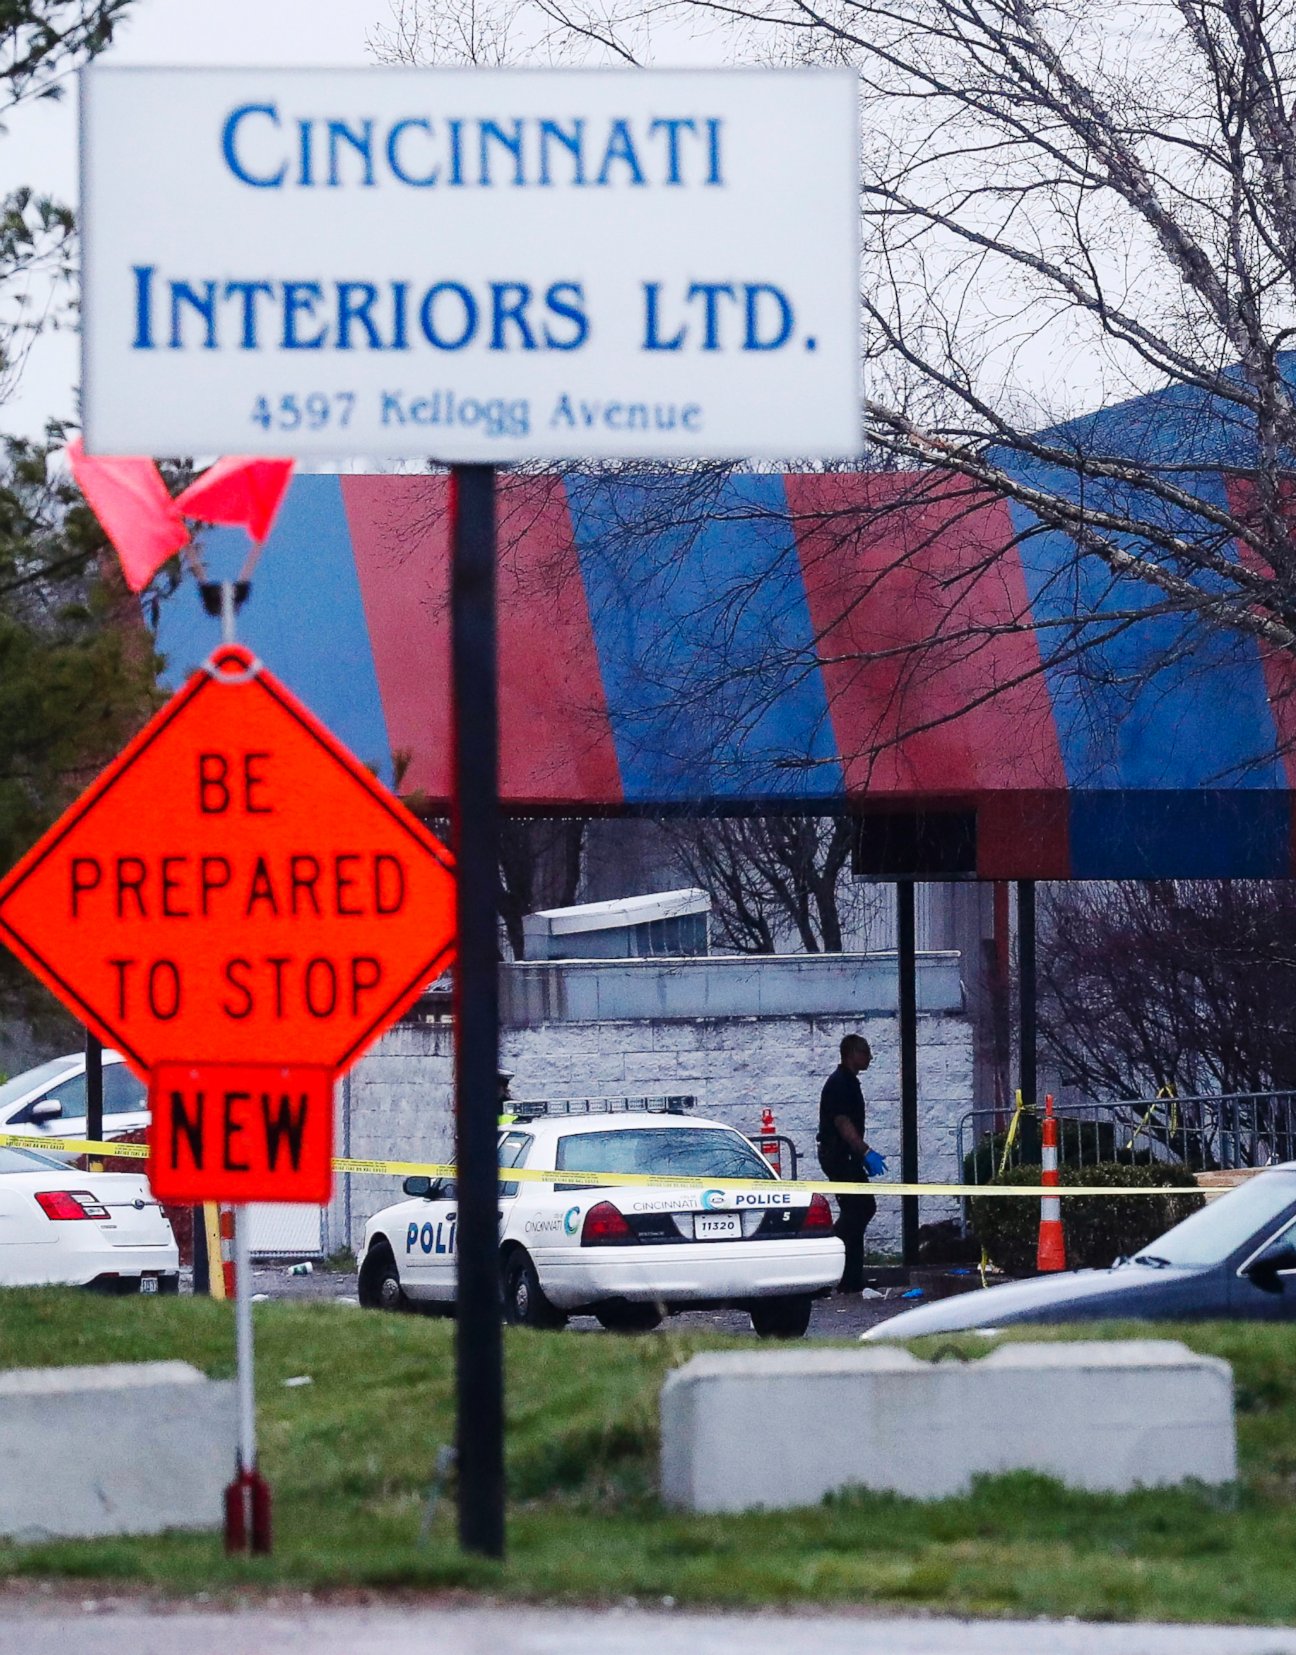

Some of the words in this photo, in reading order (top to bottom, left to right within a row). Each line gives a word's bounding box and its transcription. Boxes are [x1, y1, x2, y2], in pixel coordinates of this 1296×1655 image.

[220, 102, 725, 191] CINCINNATI
[131, 264, 590, 353] INTERIORS
[641, 281, 818, 353] LTD.
[251, 392, 356, 432] 4597
[380, 391, 530, 438] Kellogg
[550, 391, 702, 431] Avenue
[199, 753, 273, 814] BE
[70, 855, 405, 917] PREPARED
[110, 959, 181, 1021] TO
[223, 957, 382, 1020] STOP
[170, 1091, 308, 1172] NEW
[632, 1199, 698, 1212] CINCINNATI
[702, 1221, 735, 1232] 11320
[736, 1194, 791, 1206] POLICE
[782, 1211, 791, 1222] 5
[406, 1221, 456, 1254] POLI
